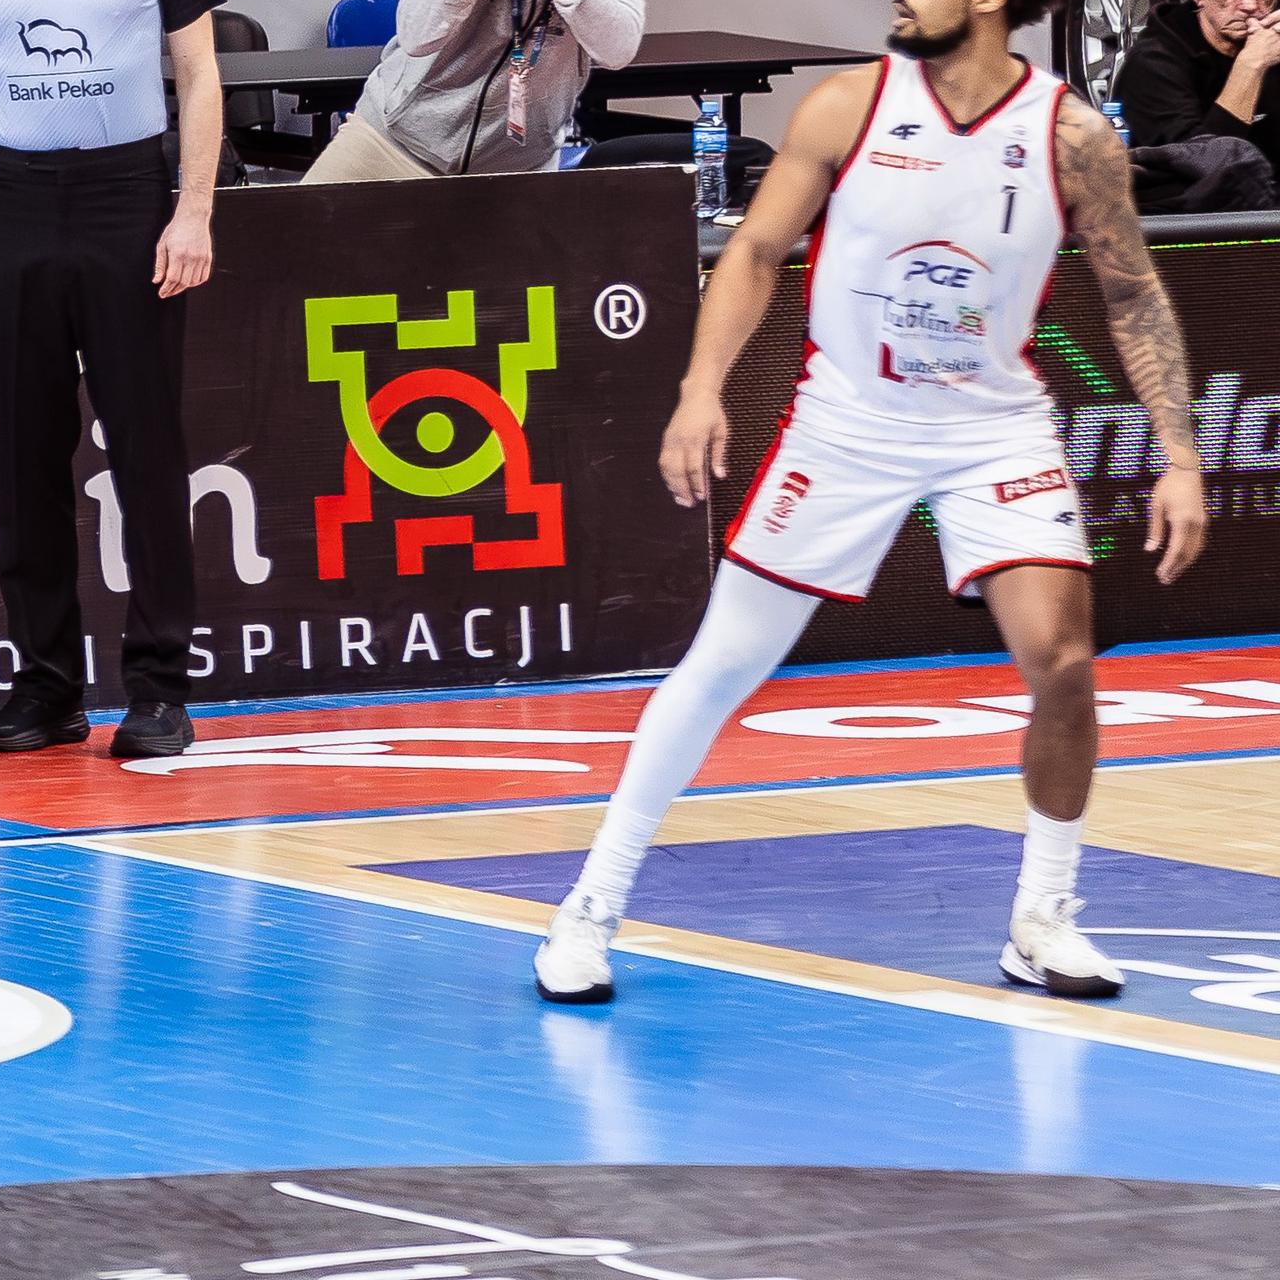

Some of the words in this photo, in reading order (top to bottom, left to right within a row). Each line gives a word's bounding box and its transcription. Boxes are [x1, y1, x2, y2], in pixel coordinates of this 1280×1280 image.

[9, 83, 54, 102] Bank
[57, 81, 115, 99] Pekao
[903, 260, 975, 289] PGE
[85, 602, 574, 686] ISPIRACJI
